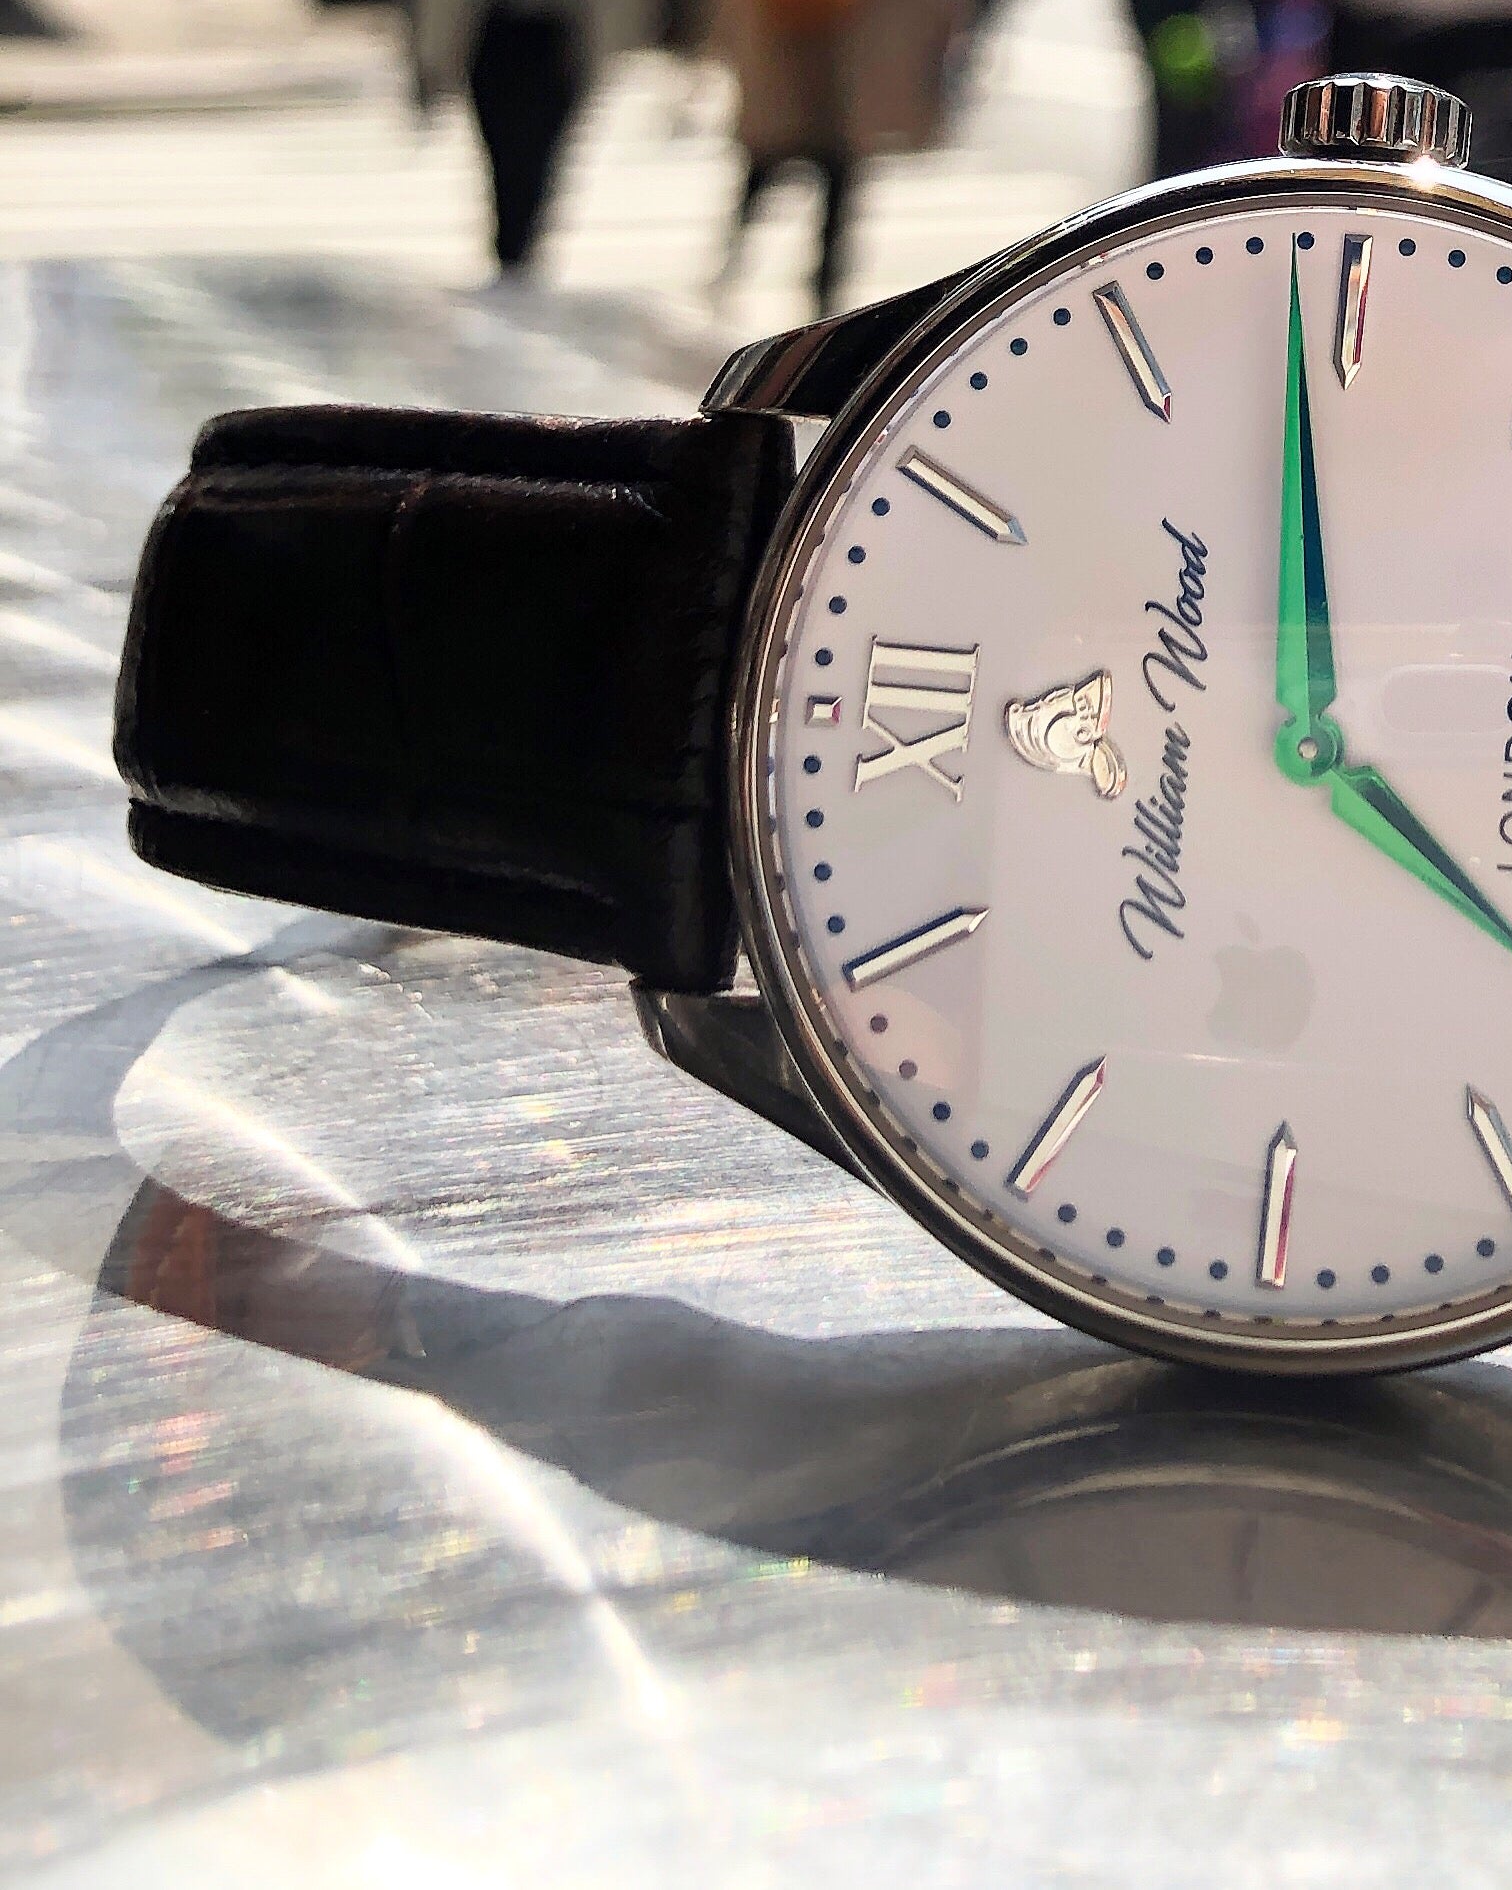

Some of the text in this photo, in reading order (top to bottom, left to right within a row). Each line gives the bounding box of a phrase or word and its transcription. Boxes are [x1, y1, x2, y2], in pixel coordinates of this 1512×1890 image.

[854, 635, 981, 803] XII
[1120, 517, 1209, 960] William Wood
